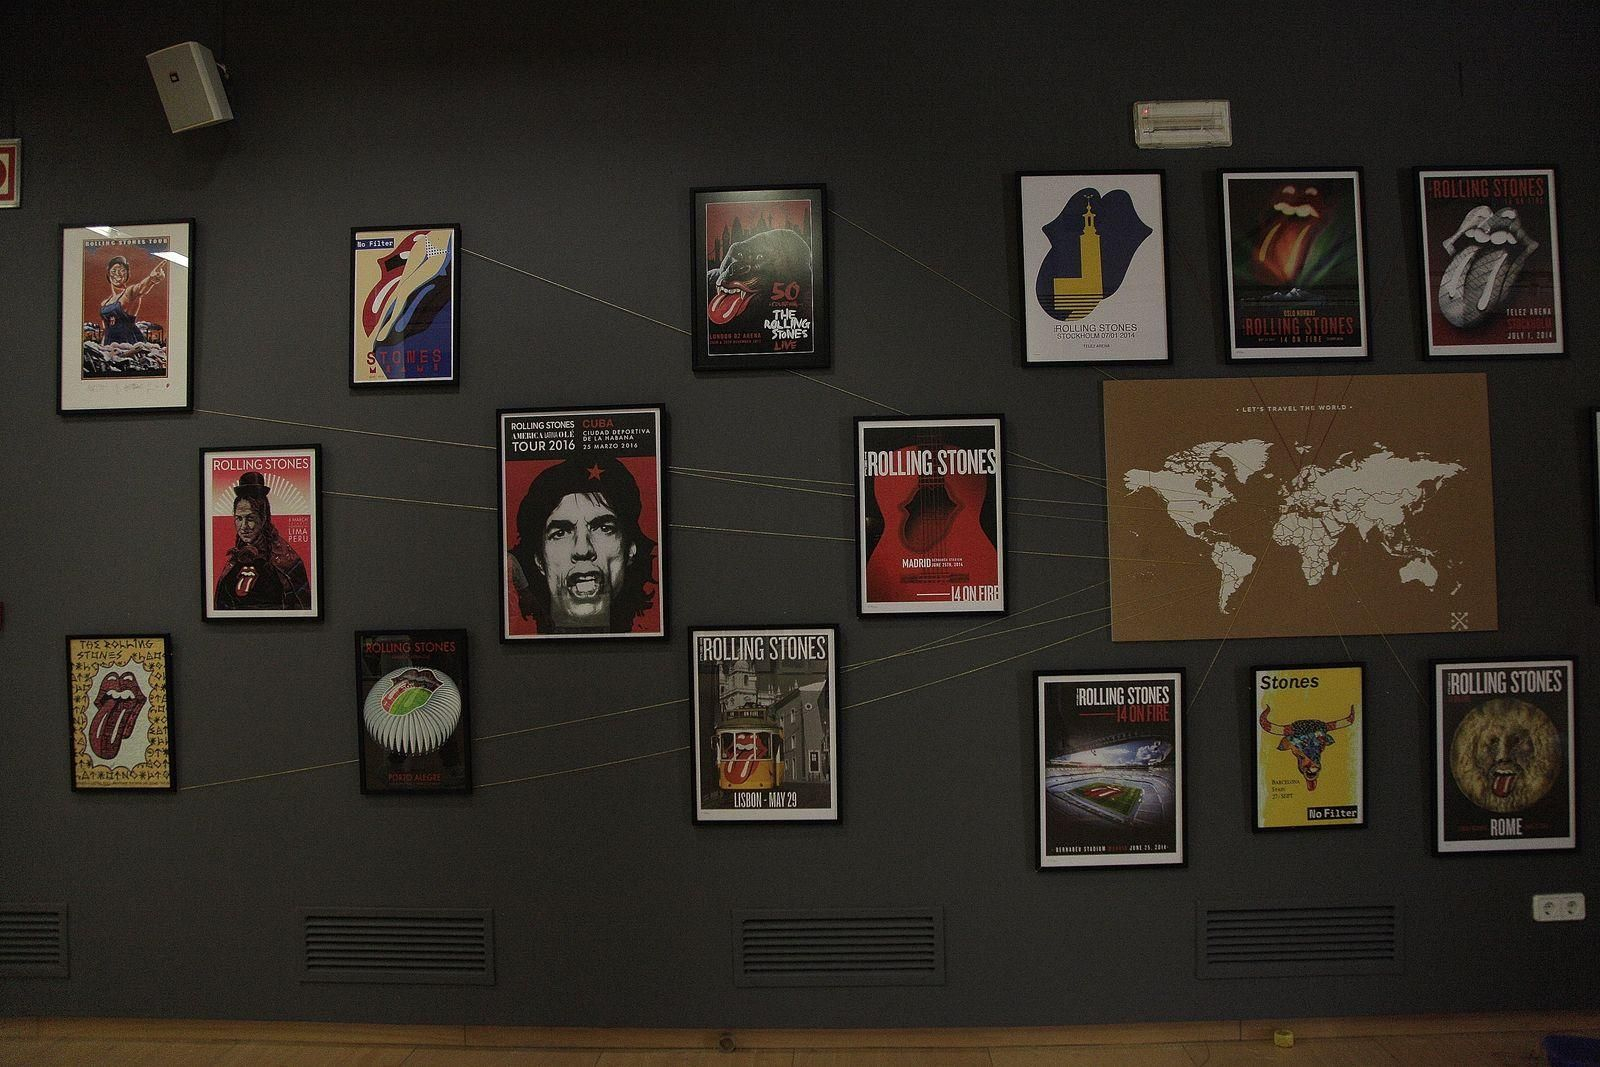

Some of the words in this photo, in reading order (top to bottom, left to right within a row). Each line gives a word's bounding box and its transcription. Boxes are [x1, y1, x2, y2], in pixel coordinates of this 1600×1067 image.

[1432, 178, 1489, 198] ROLLING
[1493, 178, 1545, 198] STONES
[770, 280, 800, 300] 50
[772, 308, 797, 321] THE
[1530, 308, 1552, 316] ARENA
[764, 317, 811, 330] ROLLING
[1055, 324, 1096, 332] ROLLING
[1099, 324, 1138, 332] STONES
[1245, 318, 1300, 336] ROLLING
[1304, 316, 1354, 335] STONES
[772, 328, 808, 340] STONES
[773, 340, 798, 351] LIVE
[366, 348, 442, 366] STONES
[511, 422, 544, 430] ROLLING
[546, 421, 575, 429] STONES
[582, 419, 615, 429] CUBA
[512, 442, 546, 451] TOUR
[549, 440, 575, 451] 2016
[213, 460, 262, 471] ROLLING
[265, 458, 309, 470] STONES
[868, 450, 933, 476] ROLLING
[937, 448, 997, 475] STONES
[902, 558, 931, 568] MADRID
[951, 585, 961, 602] 14
[962, 585, 977, 602] ON
[978, 585, 1000, 601] FIRE
[80, 640, 101, 650] THE
[104, 638, 154, 649] ROLLING
[366, 642, 411, 653] ROLLING
[414, 641, 457, 653] STONES
[704, 637, 764, 661] ROLLING
[769, 636, 826, 660] STONES
[77, 650, 122, 660] STONES
[1260, 676, 1320, 690] Stones
[1452, 671, 1507, 695] ROLLING
[1510, 670, 1562, 693] STONES
[1080, 687, 1124, 706] ROLLING
[1128, 686, 1170, 704] STONES
[1116, 705, 1127, 722] 14
[1129, 705, 1144, 722] ON
[1147, 705, 1169, 722] FIRE
[734, 792, 762, 808] LISBON
[768, 792, 786, 808] MAY
[788, 792, 797, 807] 29
[1309, 809, 1322, 819] No
[1324, 808, 1358, 818] Filter
[1491, 818, 1523, 836] ROME
